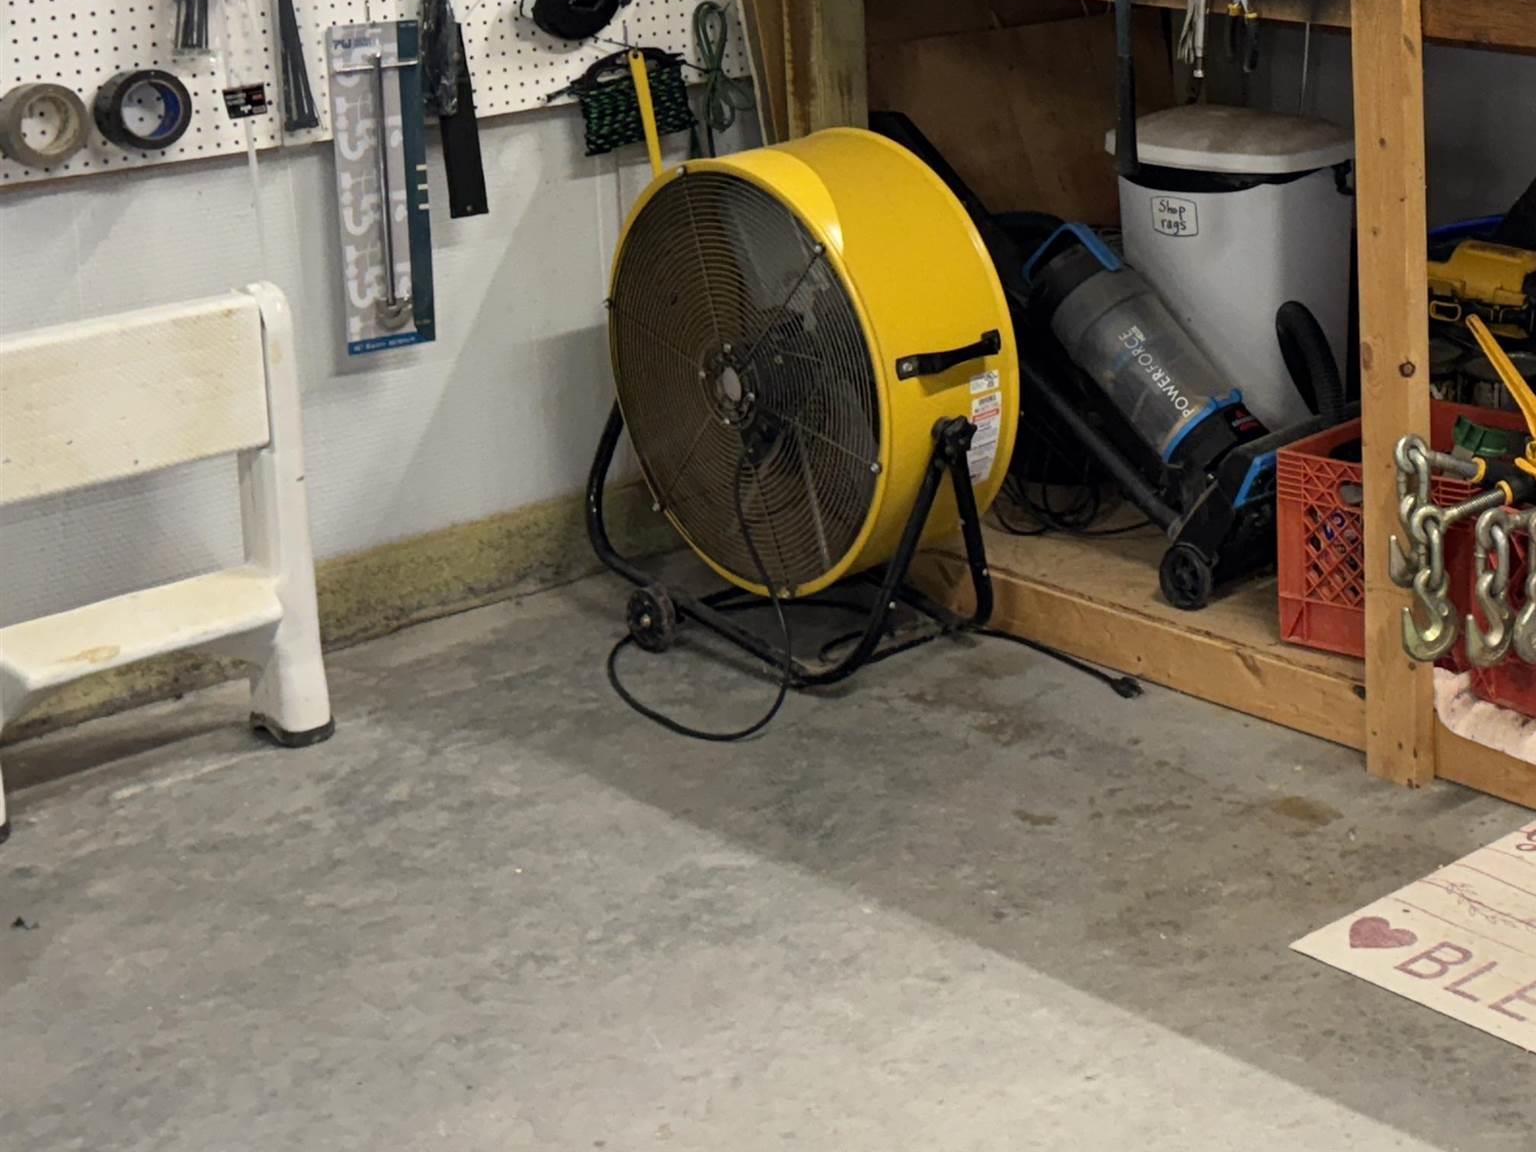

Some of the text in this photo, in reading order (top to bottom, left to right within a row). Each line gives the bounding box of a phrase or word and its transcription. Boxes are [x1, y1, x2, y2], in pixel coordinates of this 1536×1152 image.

[1159, 199, 1186, 220] Shop
[1161, 218, 1187, 237] rags
[1118, 330, 1196, 418] POWERFORCE
